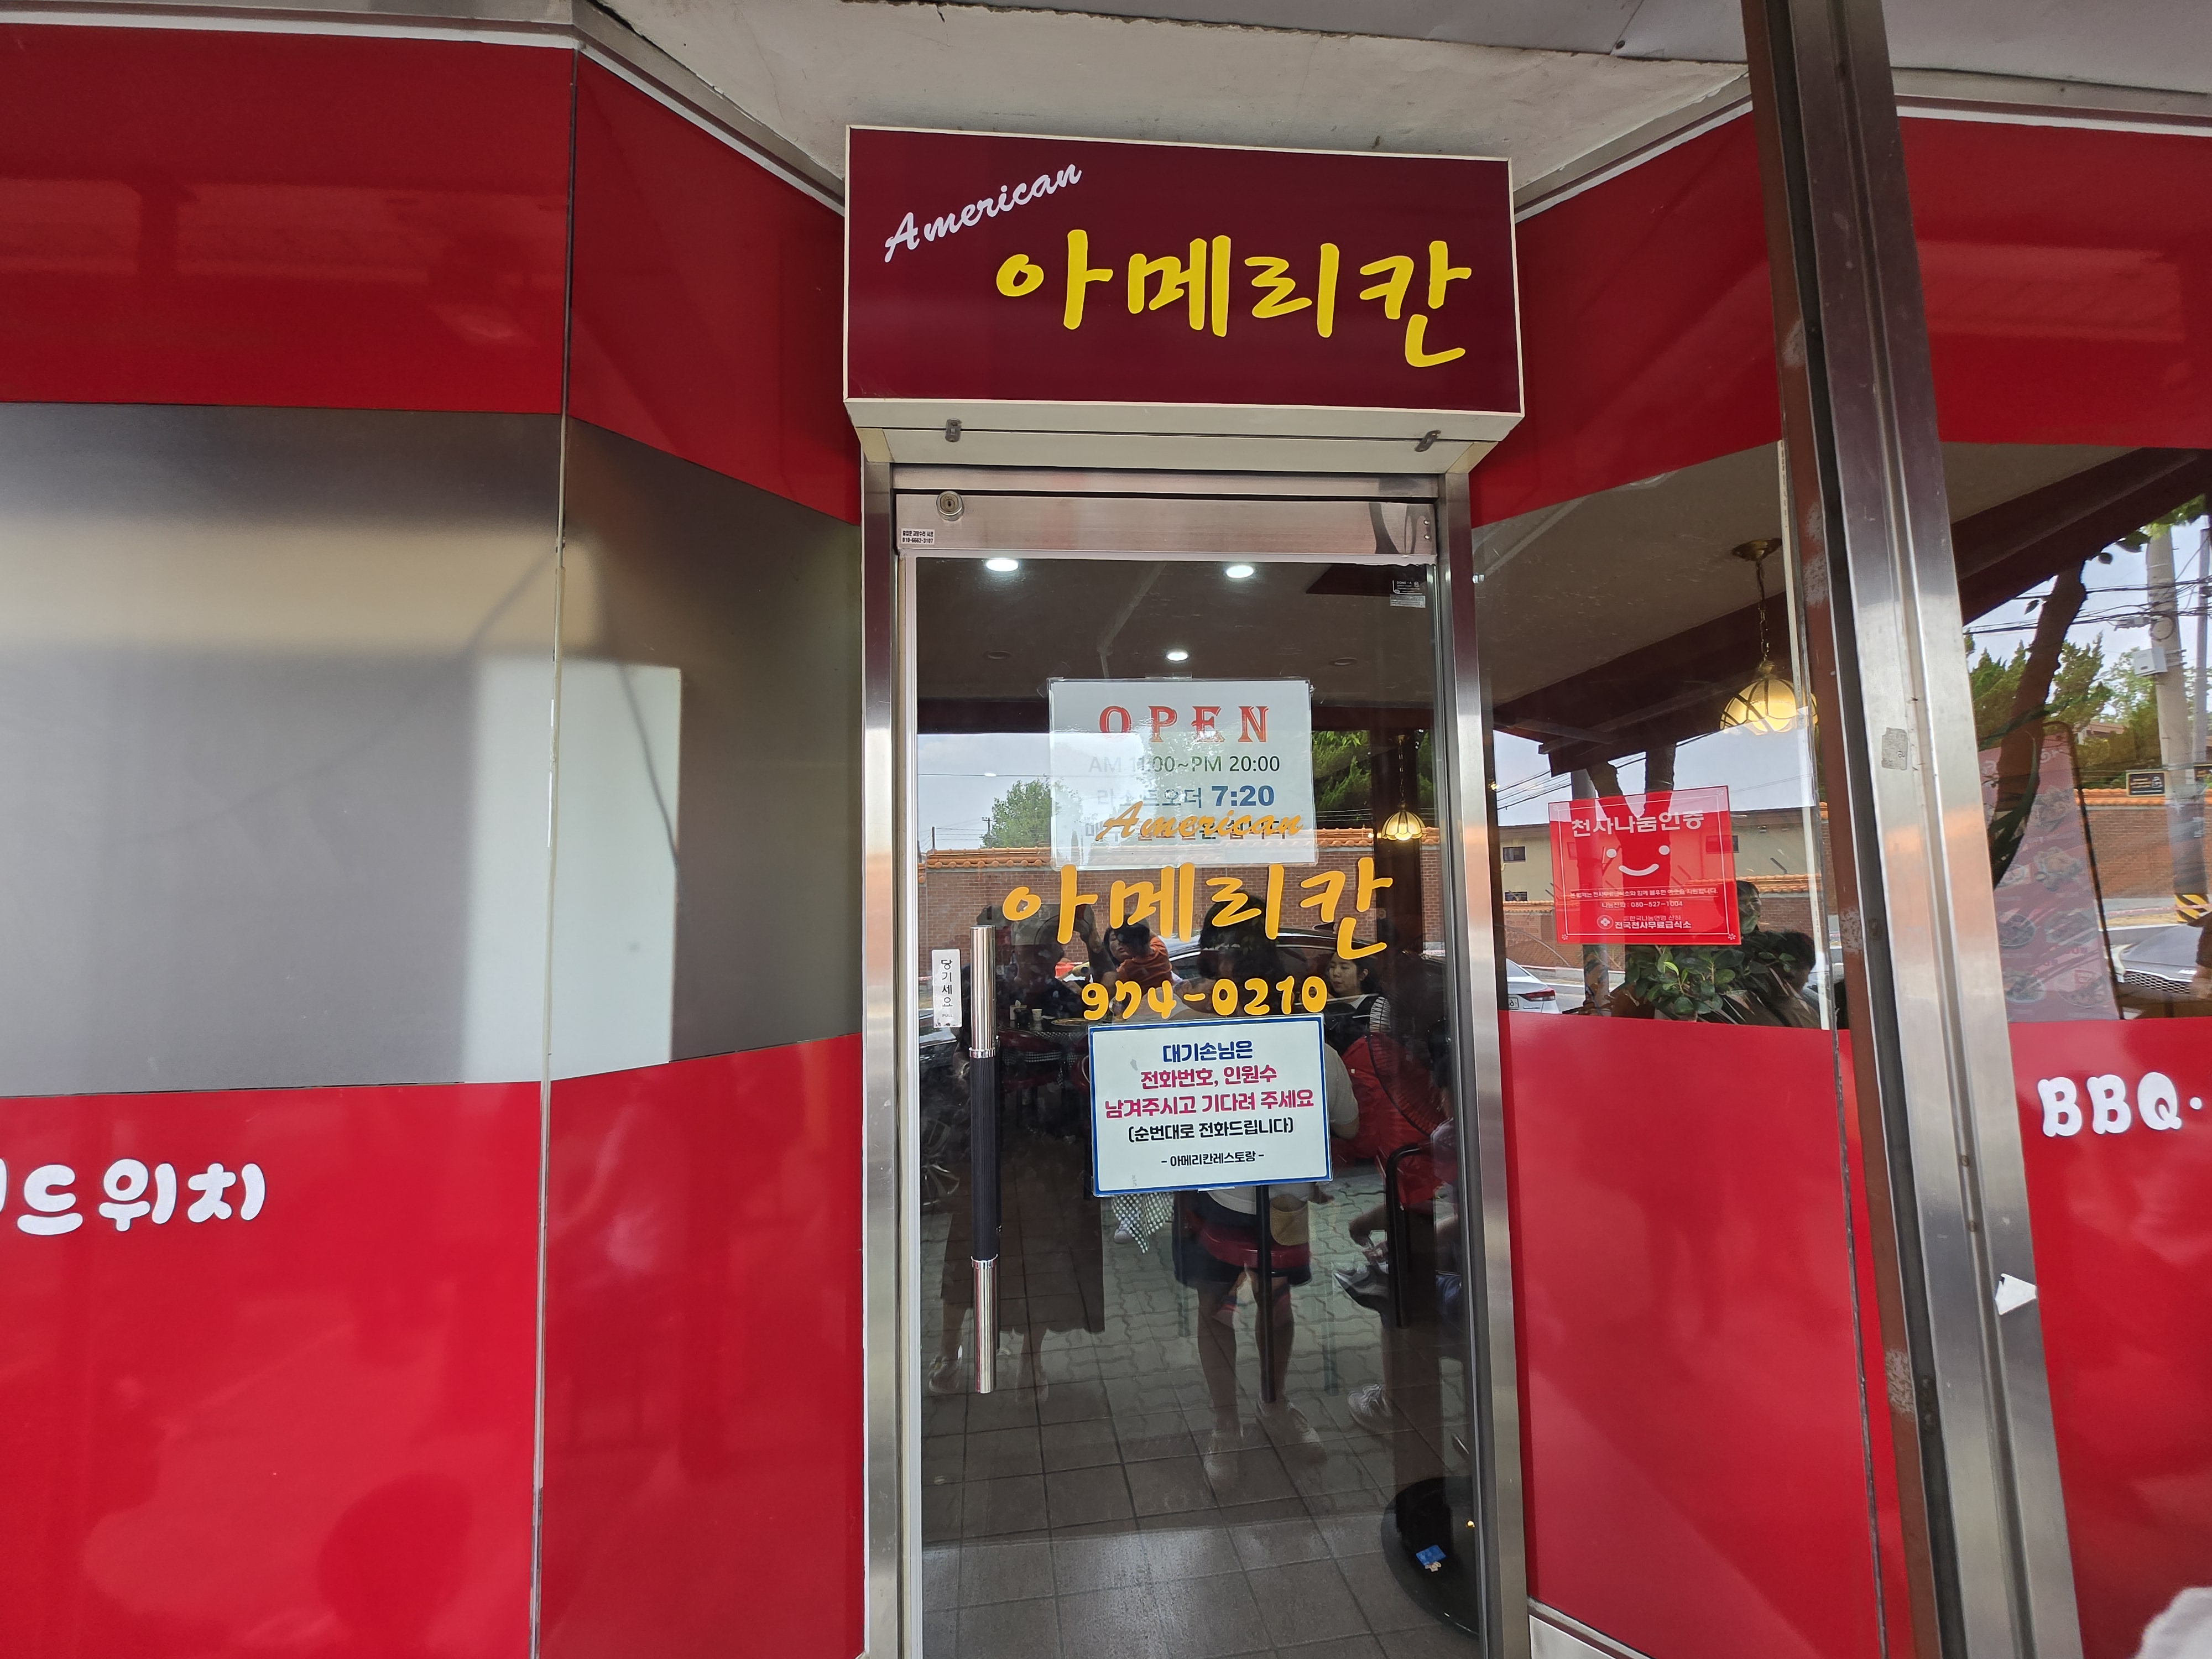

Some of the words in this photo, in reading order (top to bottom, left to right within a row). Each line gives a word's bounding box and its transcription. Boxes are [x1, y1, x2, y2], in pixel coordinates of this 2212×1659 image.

[885, 164, 1082, 262] American
[996, 229, 1472, 367] 아메리칸
[1099, 705, 1269, 743] OPEN
[1088, 756, 1121, 773] AM
[1229, 755, 1280, 773] 20:00
[1212, 785, 1275, 807] 7:20
[1095, 800, 1305, 842] American
[1571, 810, 1704, 837] 천사나눔인증
[1001, 857, 1393, 960] 아메리칸
[1615, 921, 1692, 929] 전국천사무료급식소
[941, 959, 953, 1007] 당기세요
[1082, 976, 1328, 1021] 974-0210
[1163, 1040, 1253, 1062] 대기손님은
[1140, 1067, 1219, 1089] 전화번호,
[1223, 1065, 1277, 1084] 인원수
[1105, 1095, 1197, 1119] 남겨주시고
[1202, 1092, 1256, 1113] 기다려
[1260, 1089, 1314, 1110] 주세요
[1128, 1124, 1195, 1142] (순번대로
[1198, 1117, 1293, 1138] 전화드립니다)
[1170, 1151, 1256, 1167] 아메리칸레스토랑
[0, 1158, 265, 1235] 드위치
